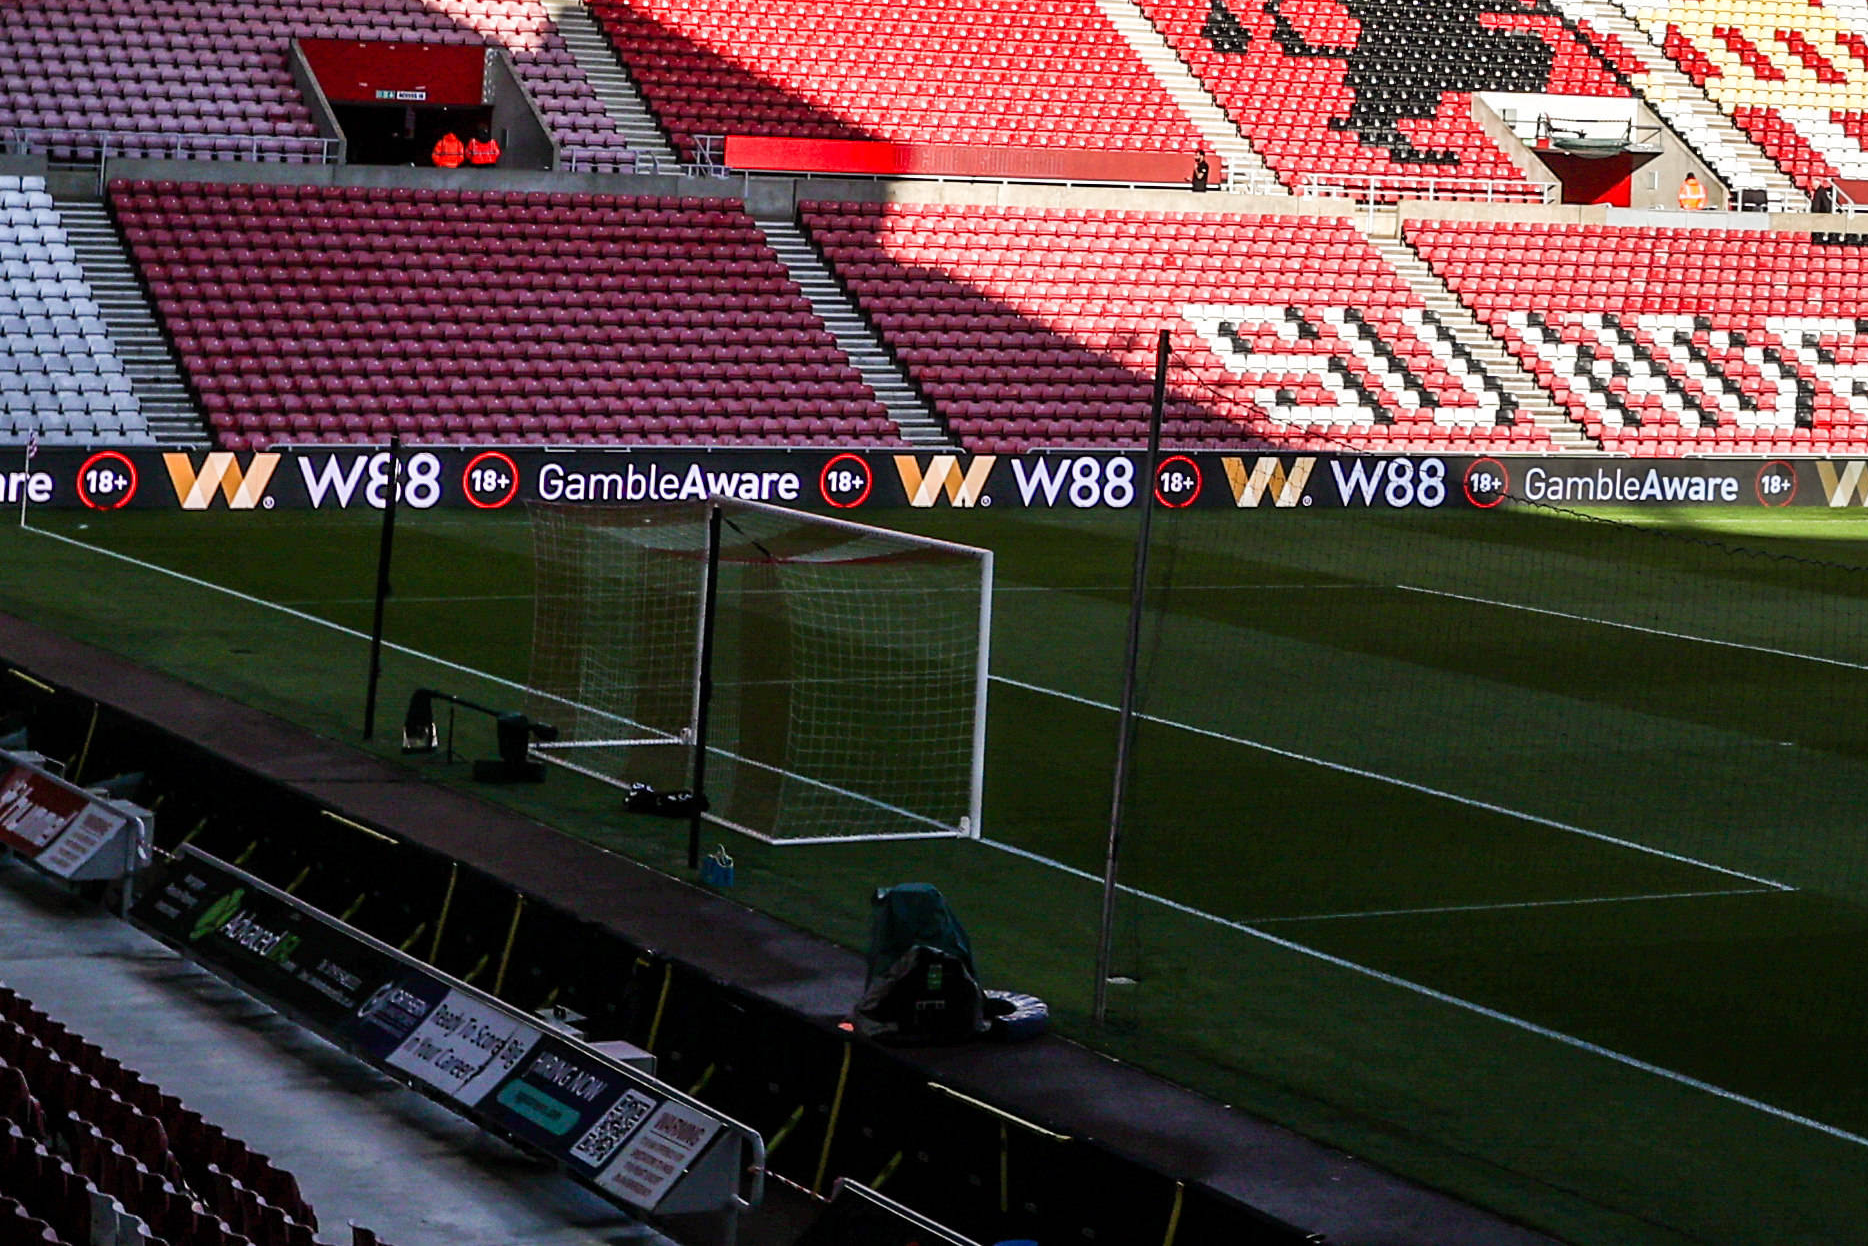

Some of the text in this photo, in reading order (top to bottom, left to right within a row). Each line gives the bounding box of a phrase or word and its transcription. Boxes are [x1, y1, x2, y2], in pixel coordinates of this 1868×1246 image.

[0, 472, 52, 502] re
[86, 469, 128, 494] 18+
[298, 452, 440, 509] W88
[471, 469, 510, 493] 18+
[539, 463, 800, 500] GambleAware
[827, 469, 864, 493] 18+
[1011, 456, 1135, 508] W88
[1160, 470, 1194, 492] 18+
[1330, 457, 1447, 508] W88
[1470, 472, 1502, 493] 18+
[1525, 467, 1739, 501] GambleAware
[1761, 474, 1791, 494] 18+
